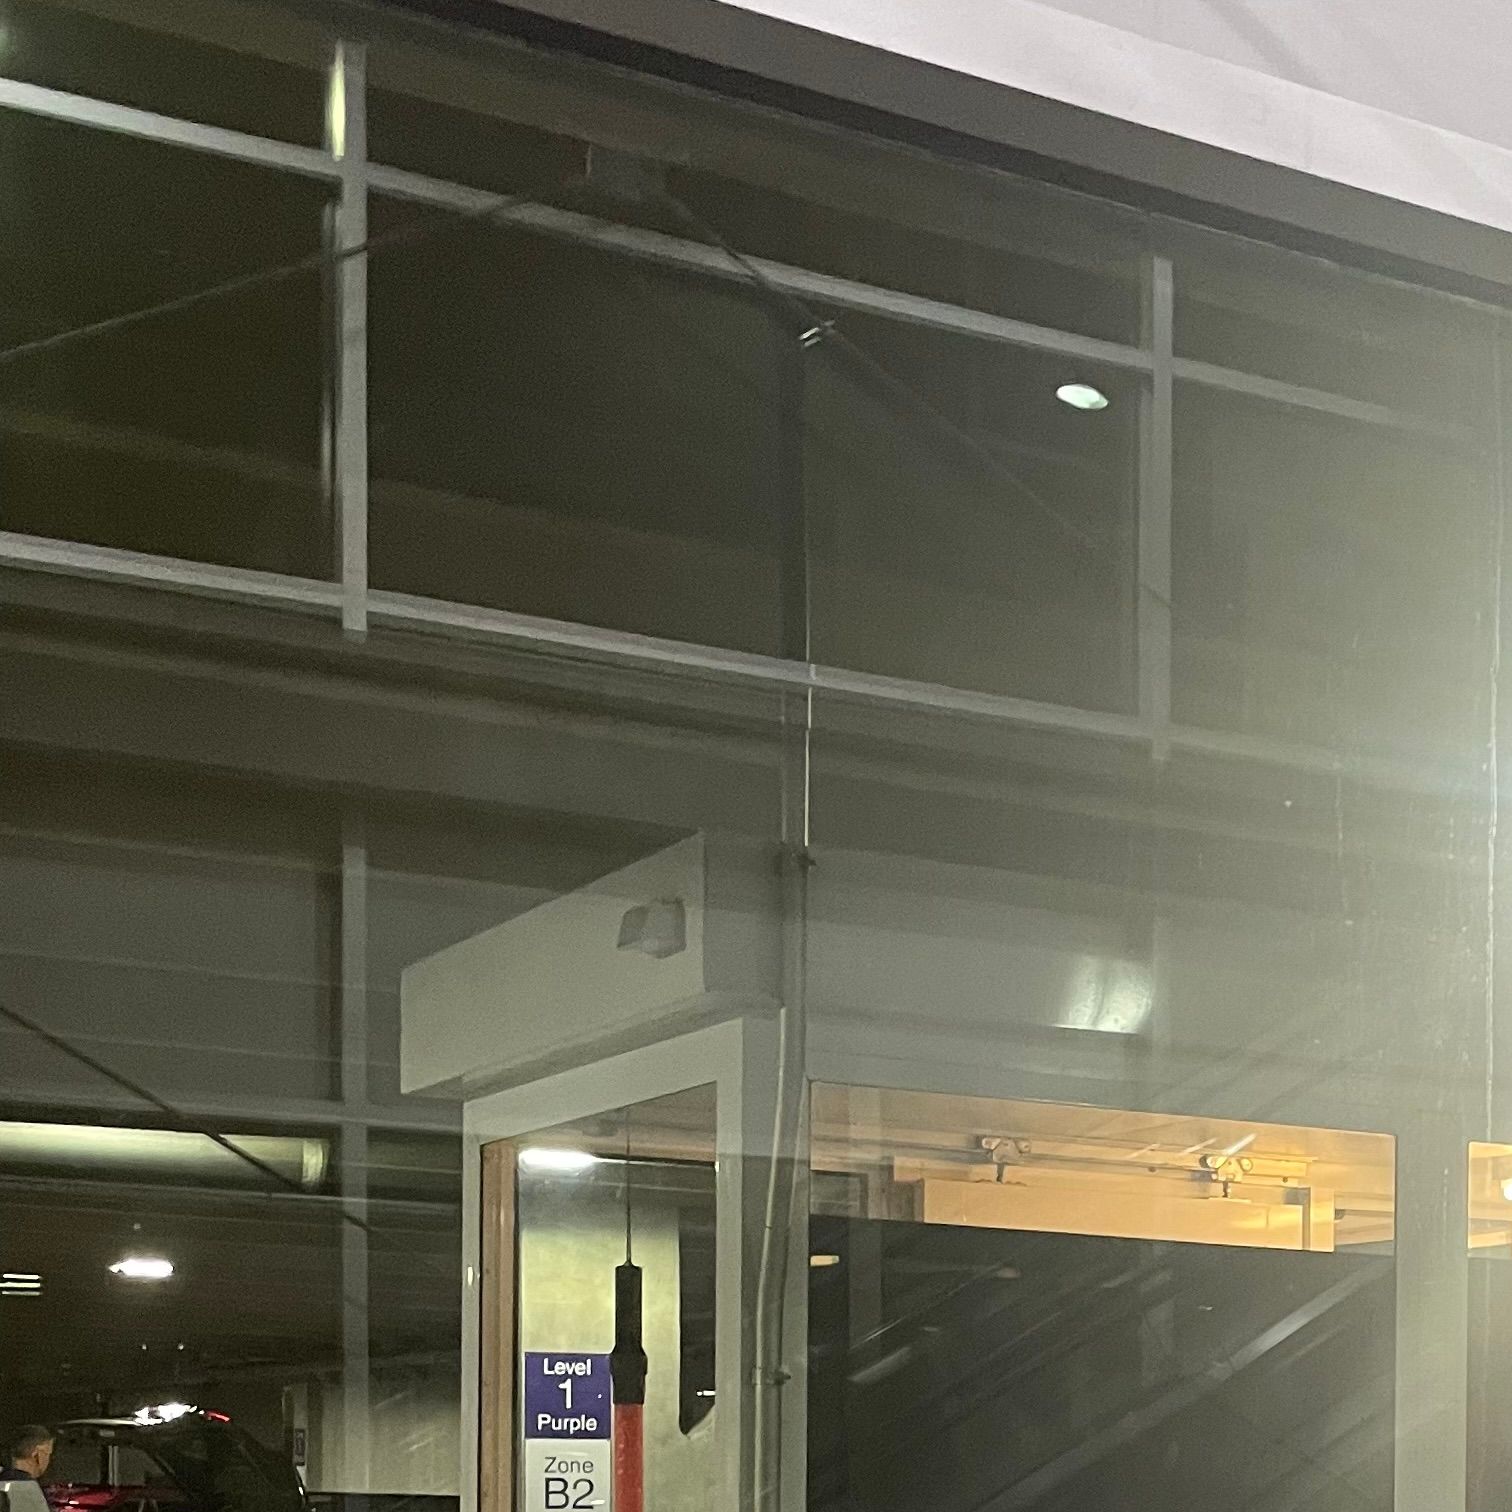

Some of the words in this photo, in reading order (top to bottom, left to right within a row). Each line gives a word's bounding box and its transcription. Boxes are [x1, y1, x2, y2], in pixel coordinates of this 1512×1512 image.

[543, 1358, 592, 1376] Level
[558, 1378, 573, 1409] 1
[537, 1413, 598, 1434] Purple
[544, 1456, 594, 1473] Zone
[544, 1477, 595, 1510] B2
